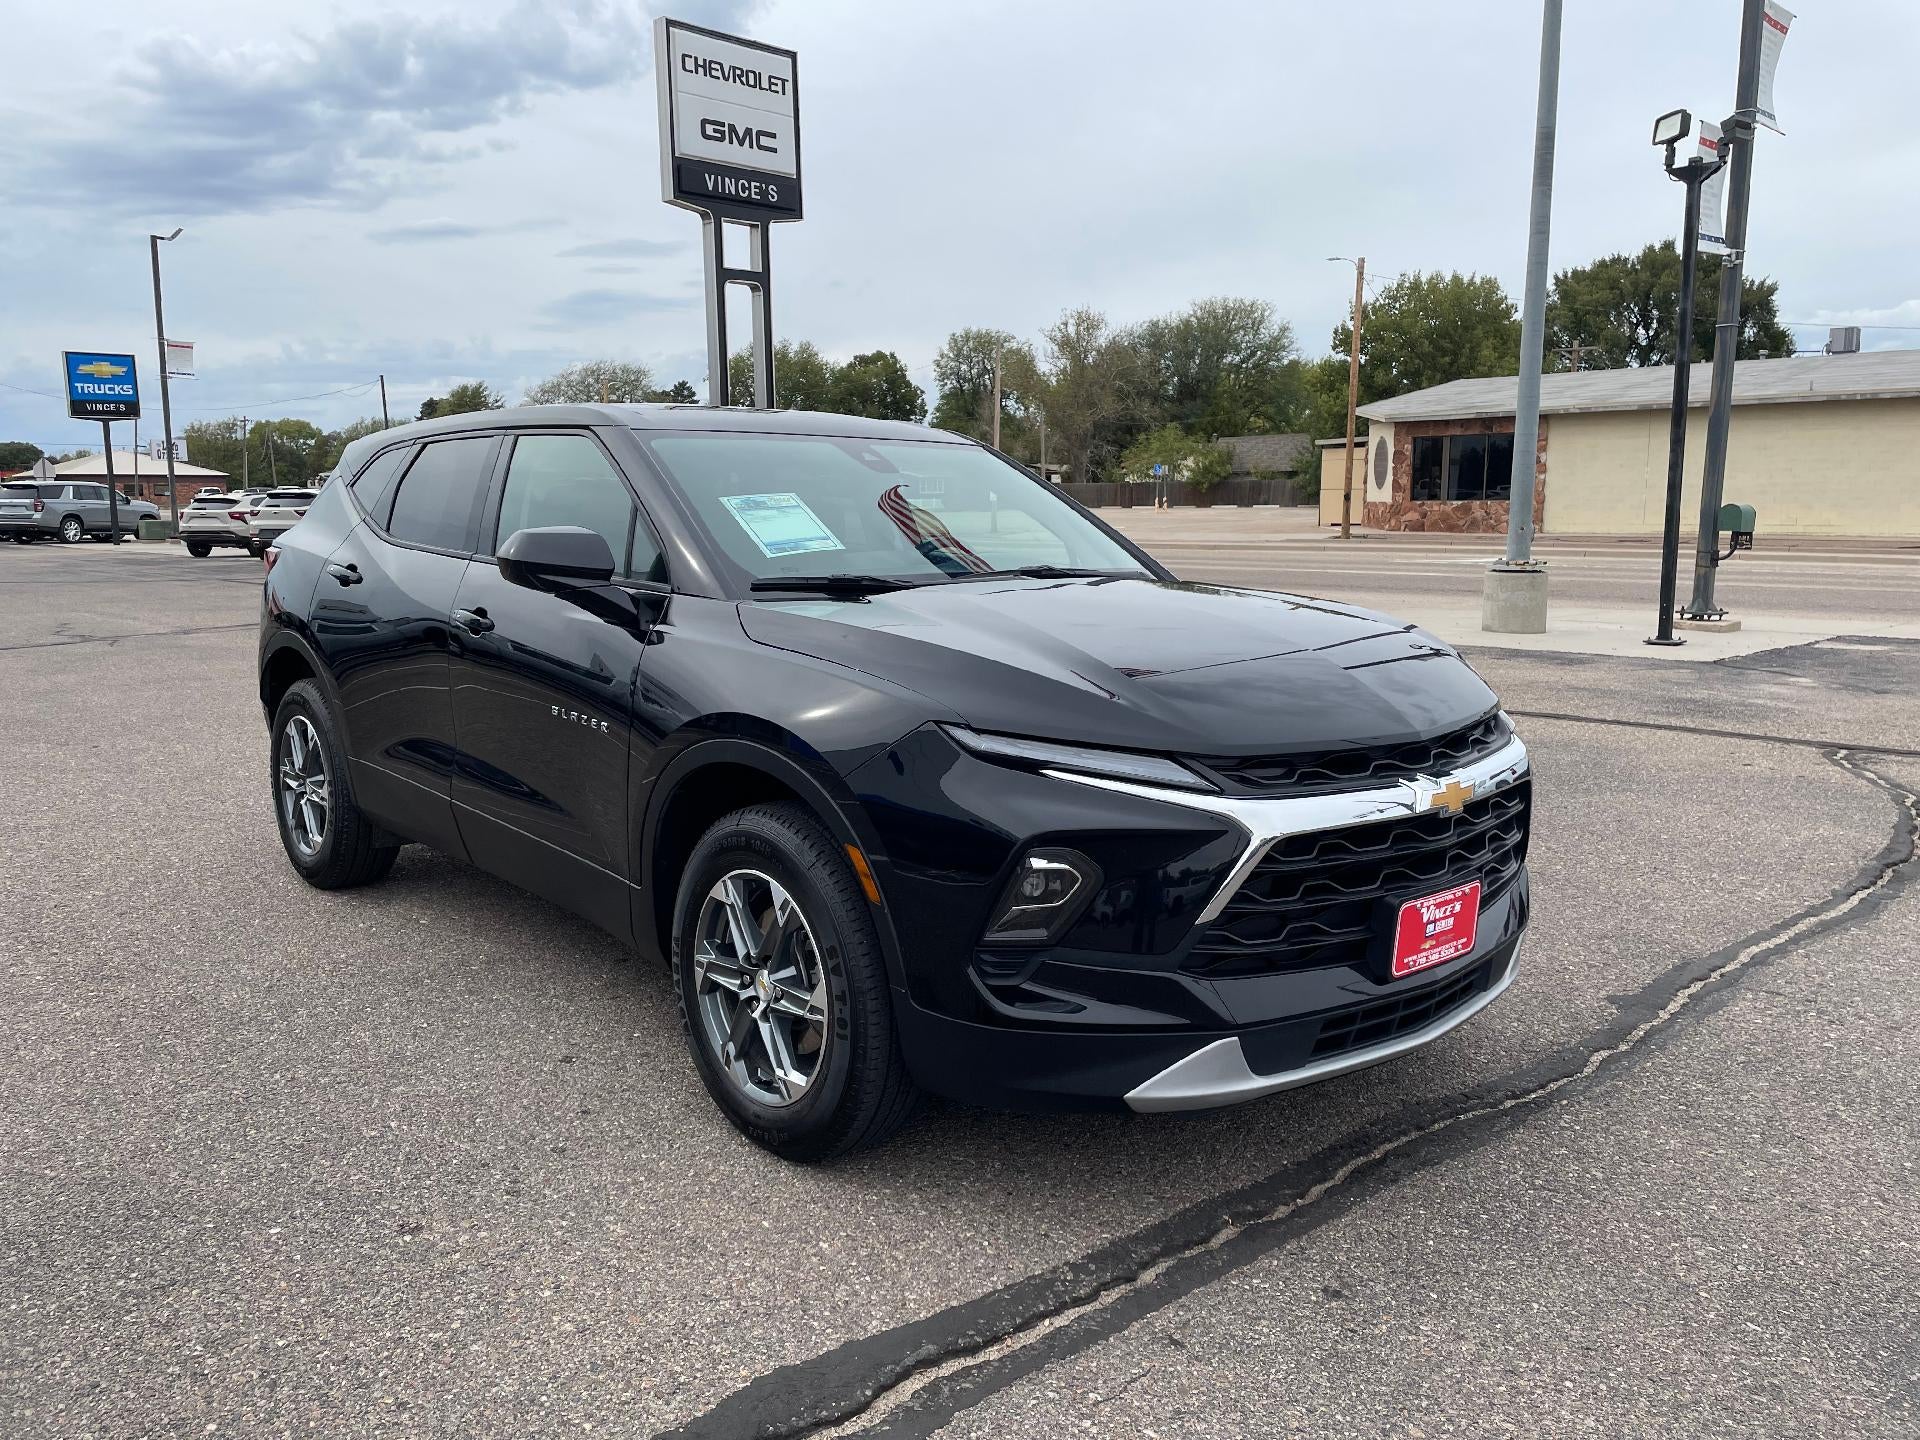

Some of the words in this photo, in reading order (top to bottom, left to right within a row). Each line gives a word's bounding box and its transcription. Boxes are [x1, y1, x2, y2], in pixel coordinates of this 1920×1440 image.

[681, 53, 789, 95] CHEVROLET
[700, 117, 778, 153] GMC
[704, 173, 778, 201] VINCE'S
[74, 382, 133, 395] TRUCKS
[86, 403, 126, 411] VINCE'S
[157, 449, 180, 460] OFCE
[551, 705, 608, 733] BLAZER
[1435, 917, 1454, 930] CENTER
